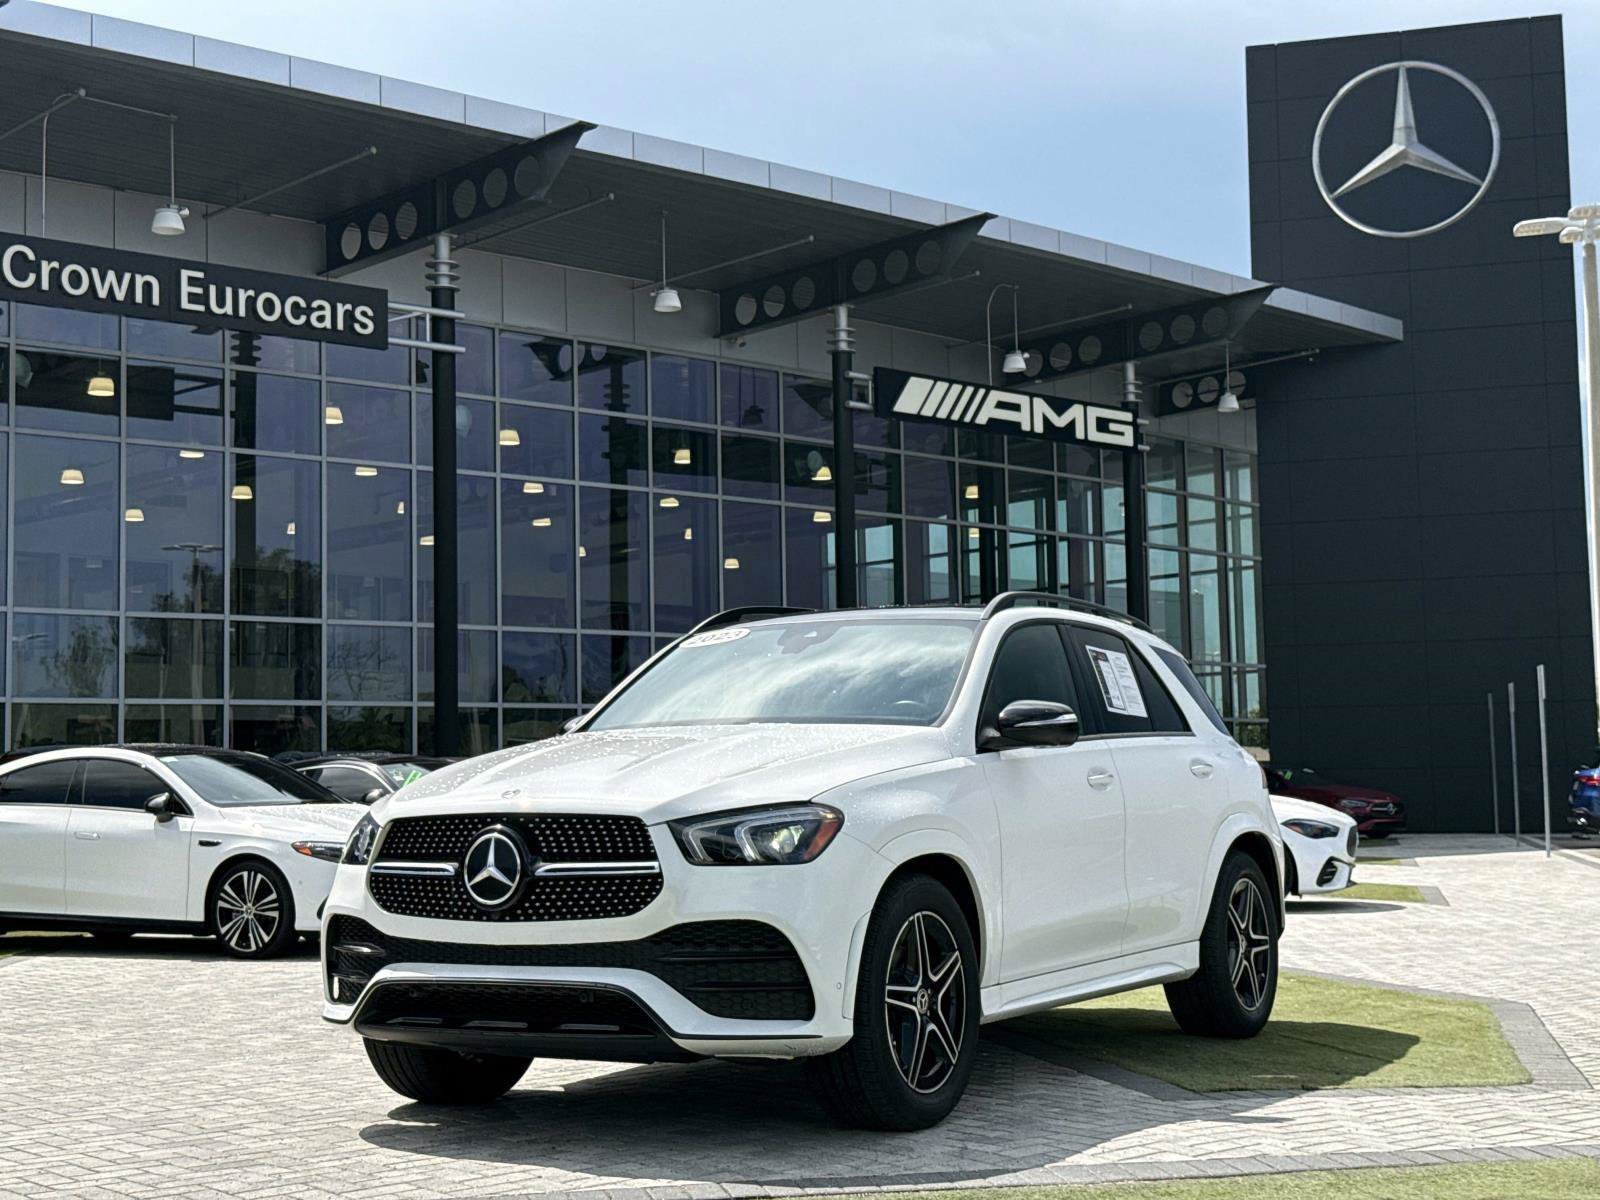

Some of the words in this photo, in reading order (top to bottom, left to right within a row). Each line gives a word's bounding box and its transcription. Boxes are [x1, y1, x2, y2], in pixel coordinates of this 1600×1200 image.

[2, 244, 160, 306] Crown
[180, 268, 375, 336] Eurocars
[974, 389, 1134, 447] AMG
